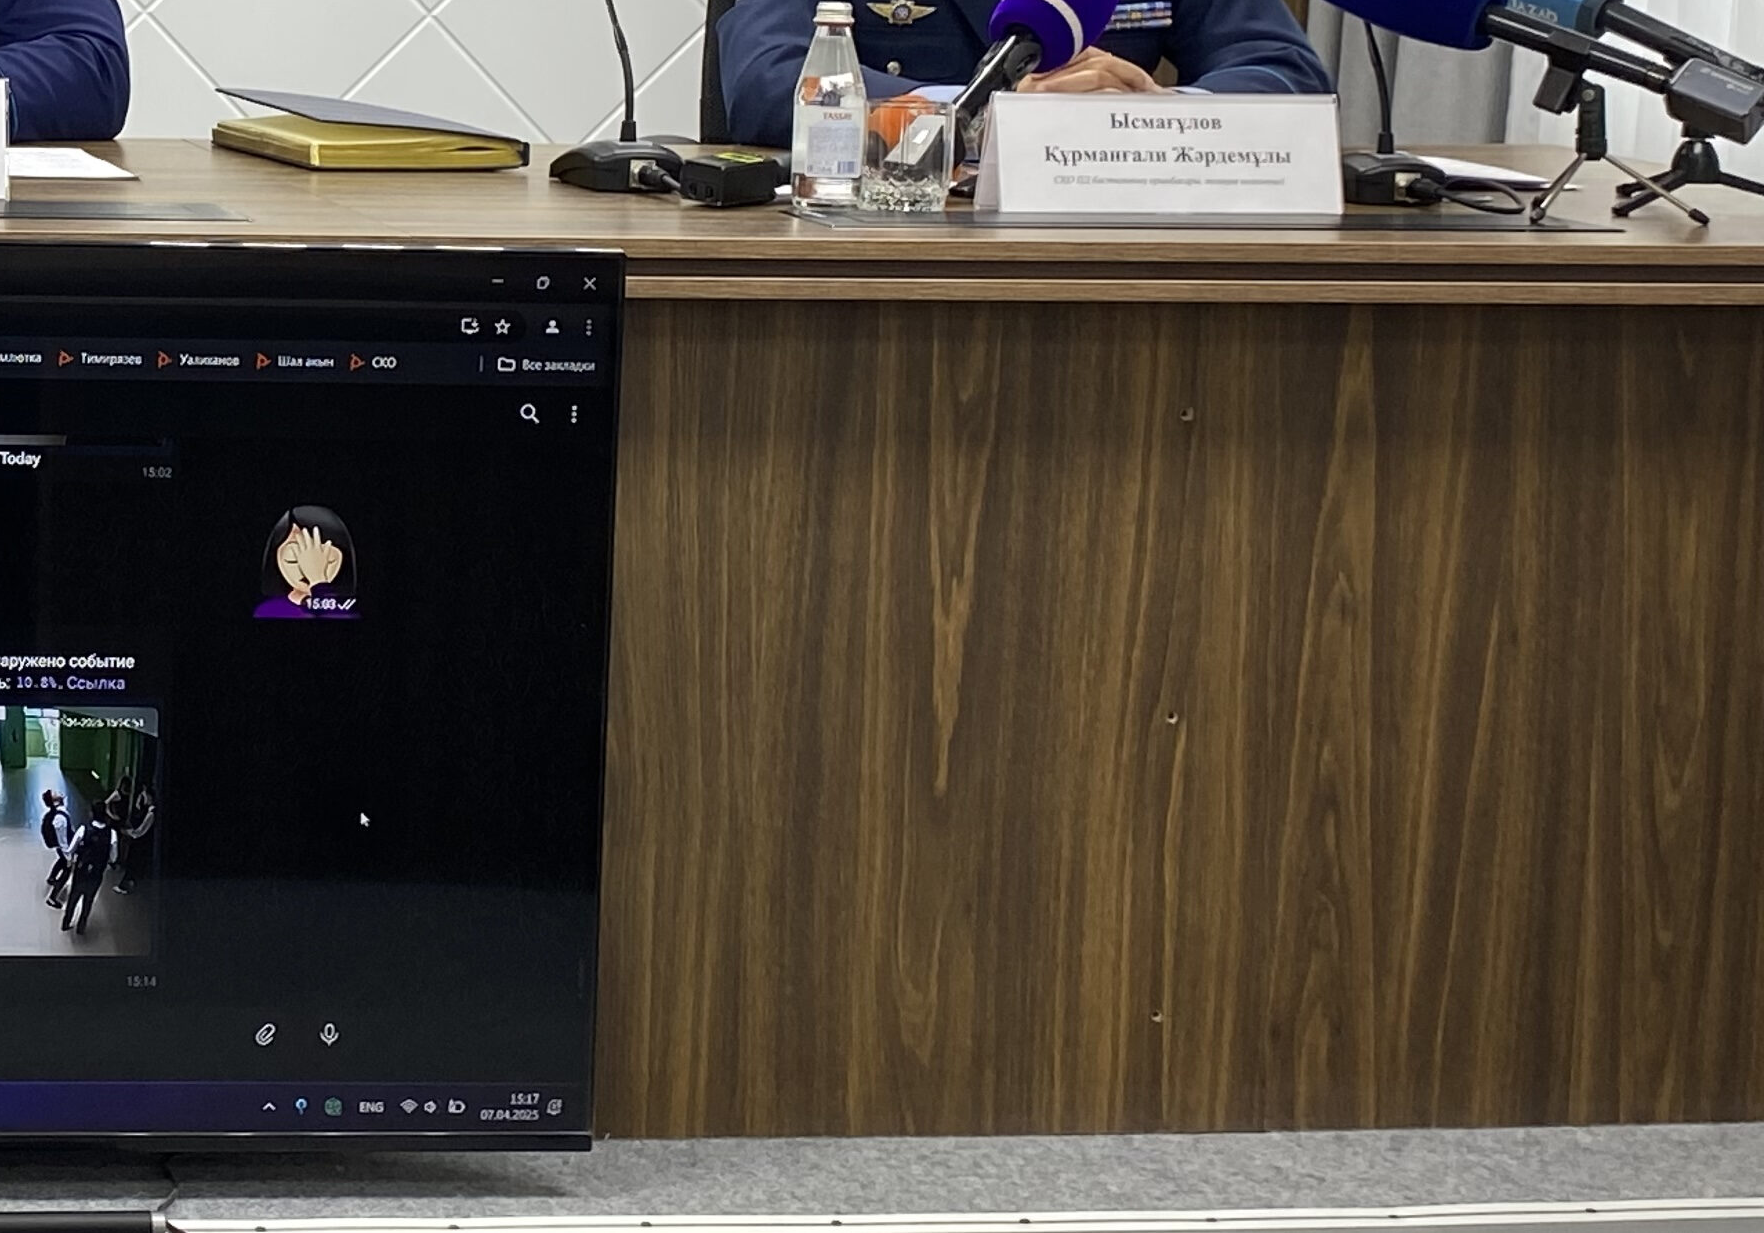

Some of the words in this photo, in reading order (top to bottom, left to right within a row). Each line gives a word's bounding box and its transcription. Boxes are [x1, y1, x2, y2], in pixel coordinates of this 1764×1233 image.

[0, 451, 42, 468] Today
[142, 467, 173, 479] 15:02
[69, 653, 135, 669] событие
[67, 675, 125, 690] Ссылка
[510, 1093, 540, 1105] 15:17
[359, 1101, 385, 1113] ENG
